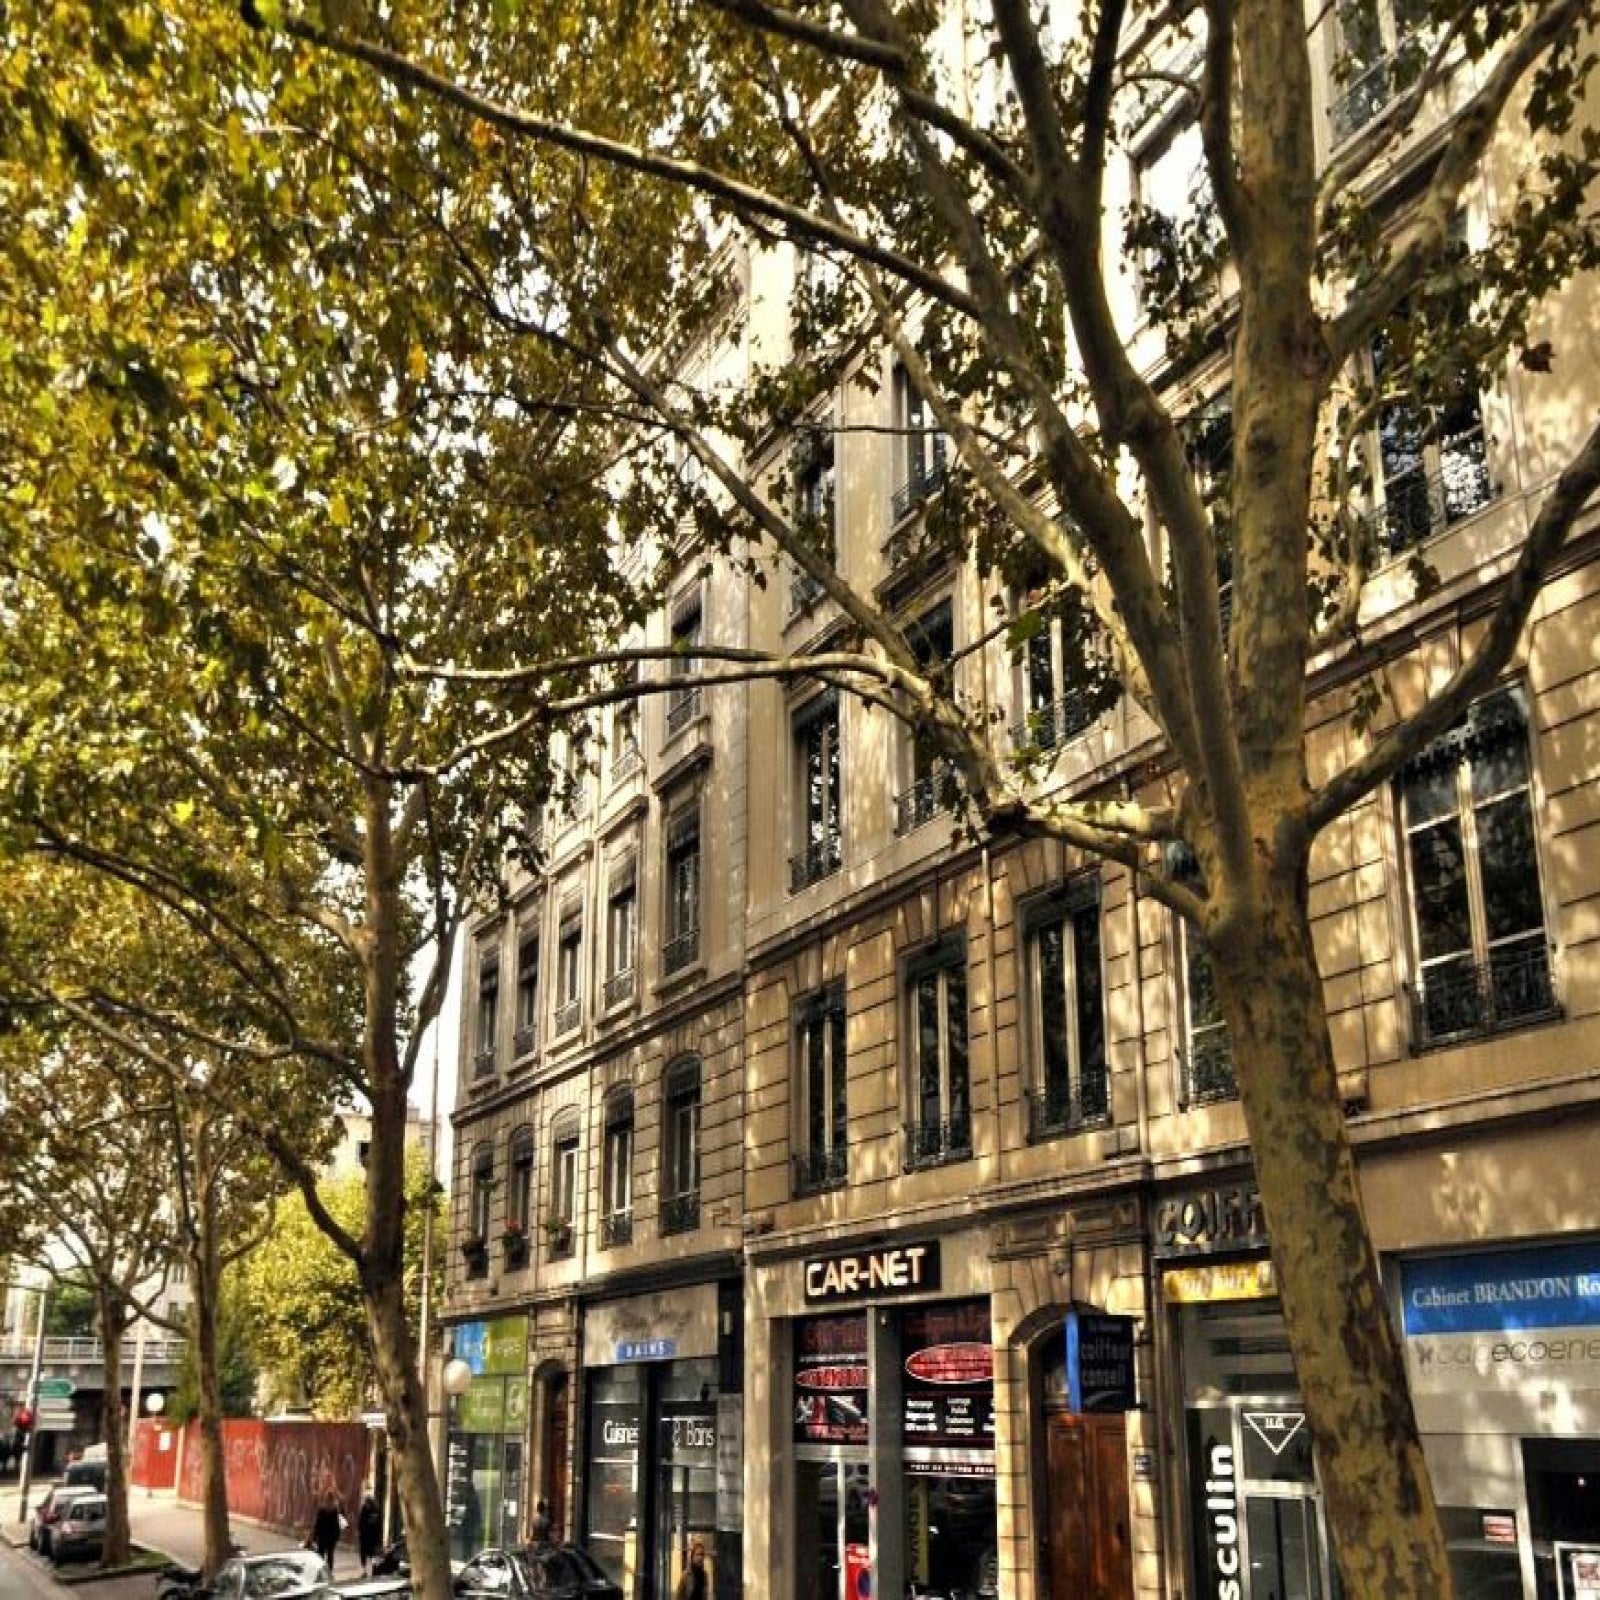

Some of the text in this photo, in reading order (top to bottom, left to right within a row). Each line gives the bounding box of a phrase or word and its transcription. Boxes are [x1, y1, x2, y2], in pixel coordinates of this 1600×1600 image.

[806, 1247, 926, 1296] CAR-NET
[1412, 1287, 1469, 1308] Cabinet
[1473, 1276, 1572, 1303] BRANDON
